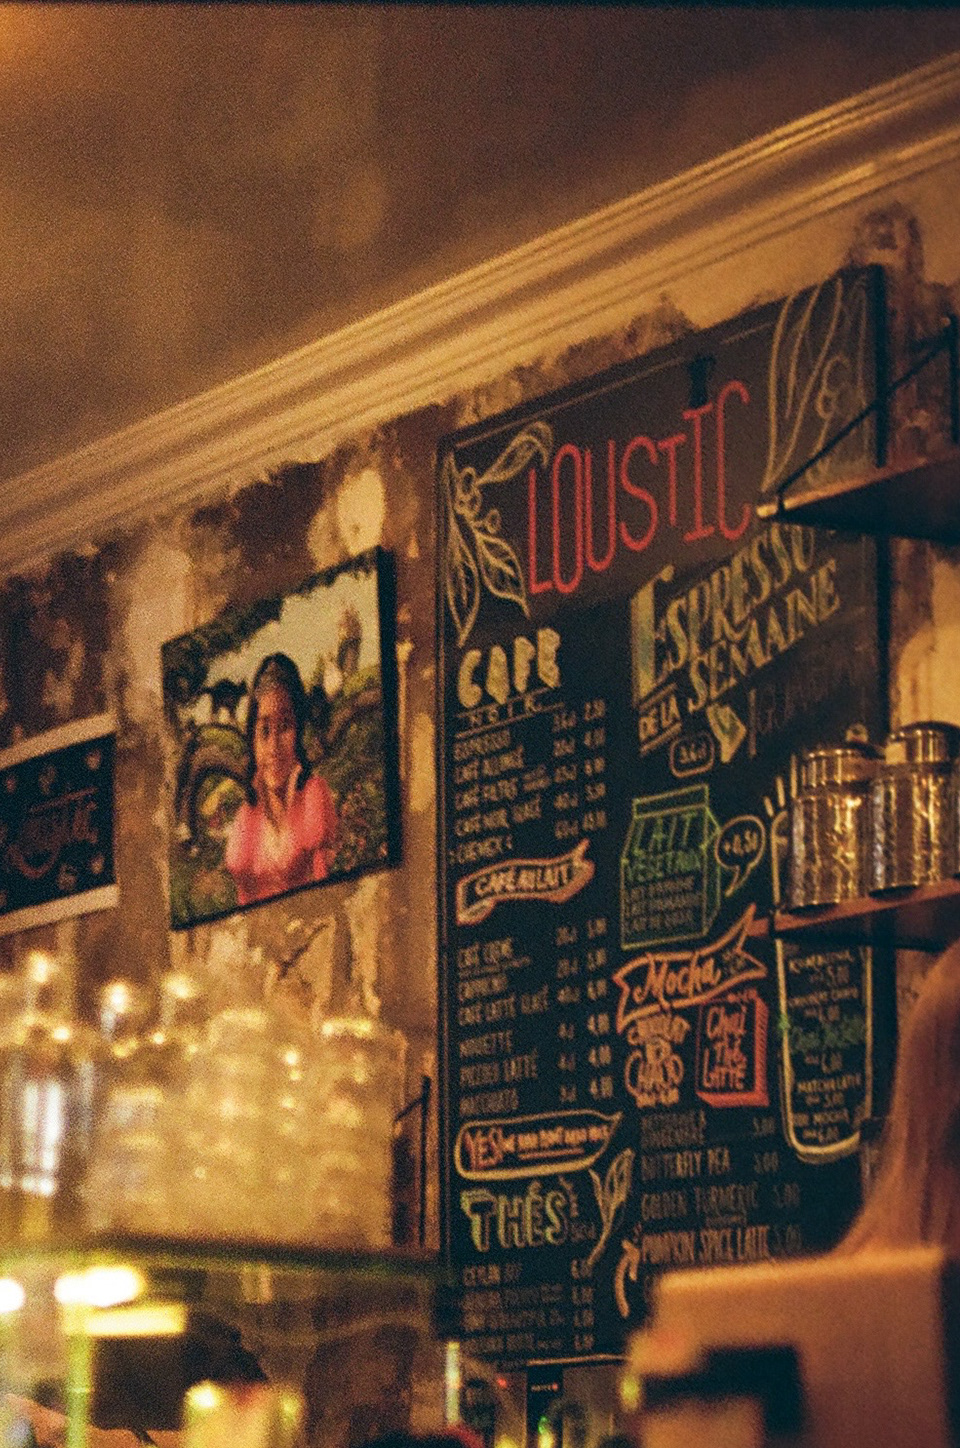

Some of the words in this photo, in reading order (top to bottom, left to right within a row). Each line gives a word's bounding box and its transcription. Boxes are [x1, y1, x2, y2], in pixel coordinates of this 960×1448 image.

[528, 380, 750, 594] LOUSTIC
[688, 558, 839, 713] SEMAINE
[639, 711, 658, 742] DE
[660, 694, 681, 728] LA
[632, 952, 721, 1009] Mocha
